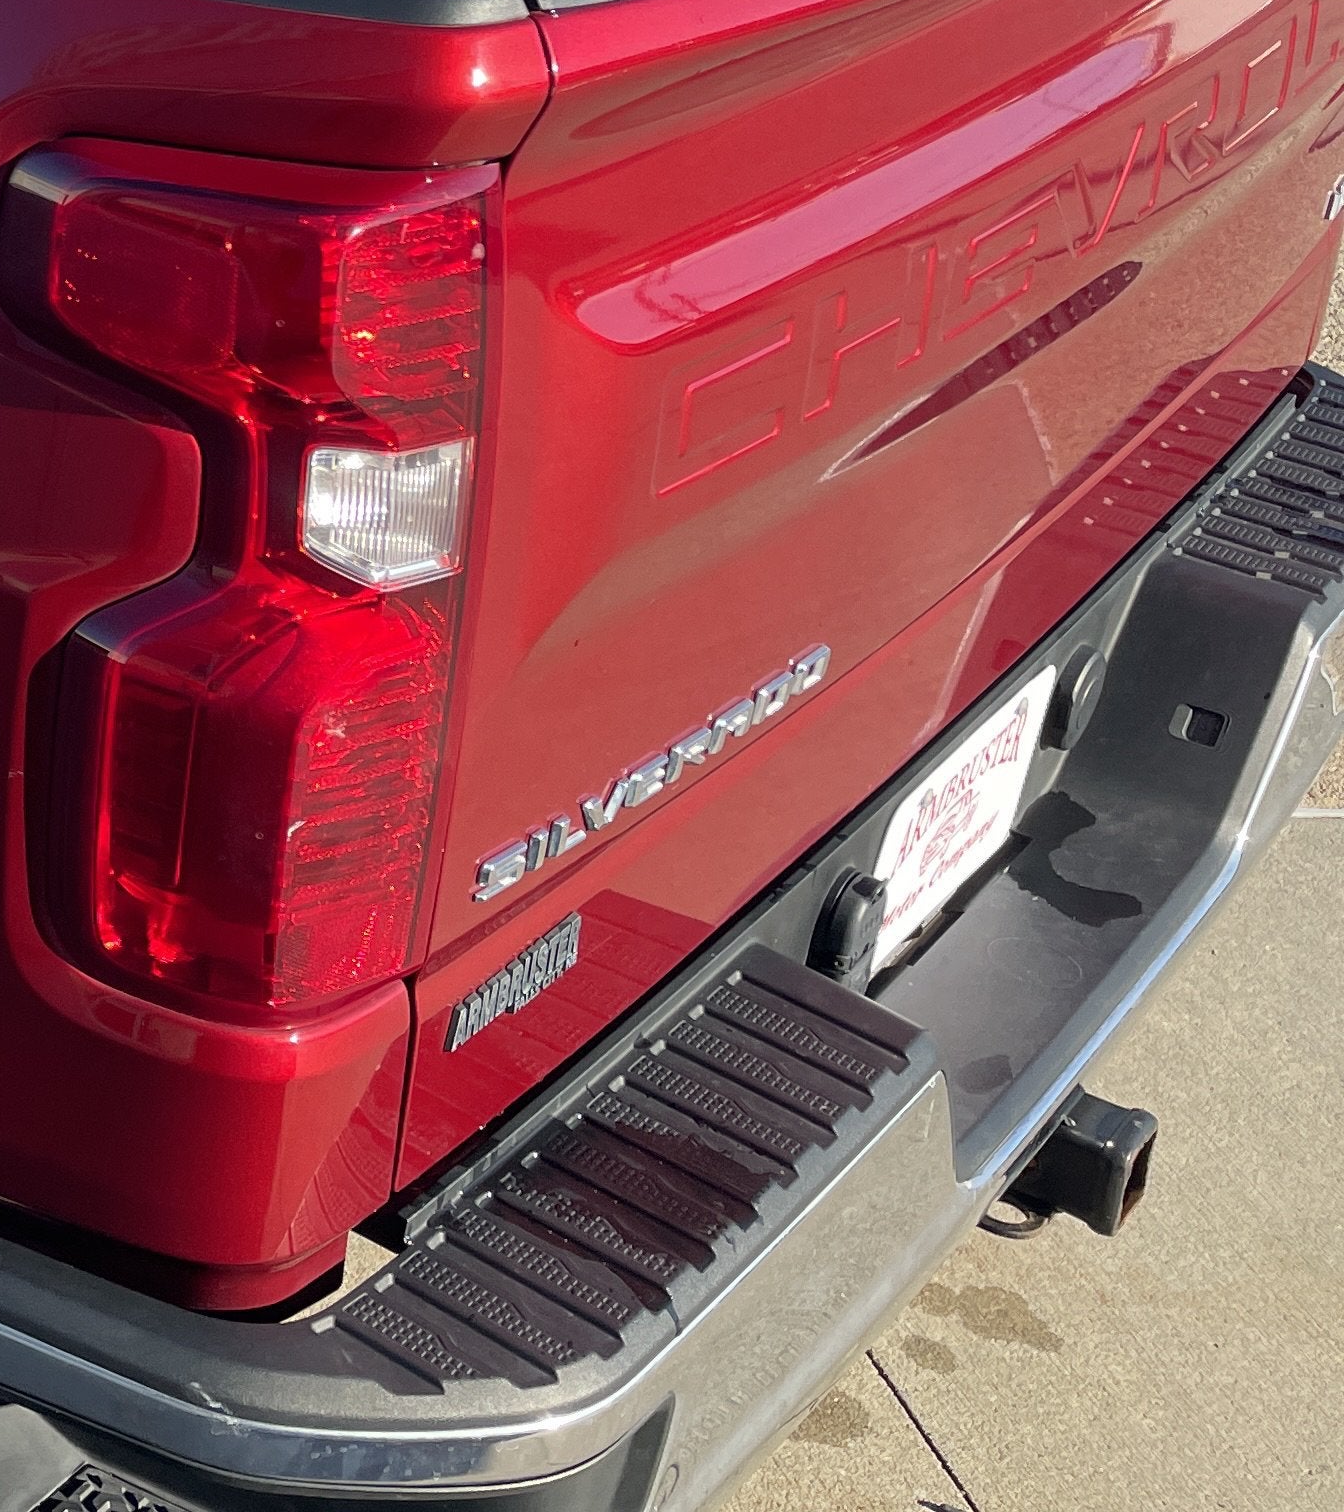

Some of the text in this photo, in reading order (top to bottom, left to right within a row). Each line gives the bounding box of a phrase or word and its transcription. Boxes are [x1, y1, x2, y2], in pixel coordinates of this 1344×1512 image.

[470, 644, 831, 903] SILVERADO
[890, 710, 1028, 880] ARMBRUSTER
[445, 912, 581, 1052] ARMBRUSTER
